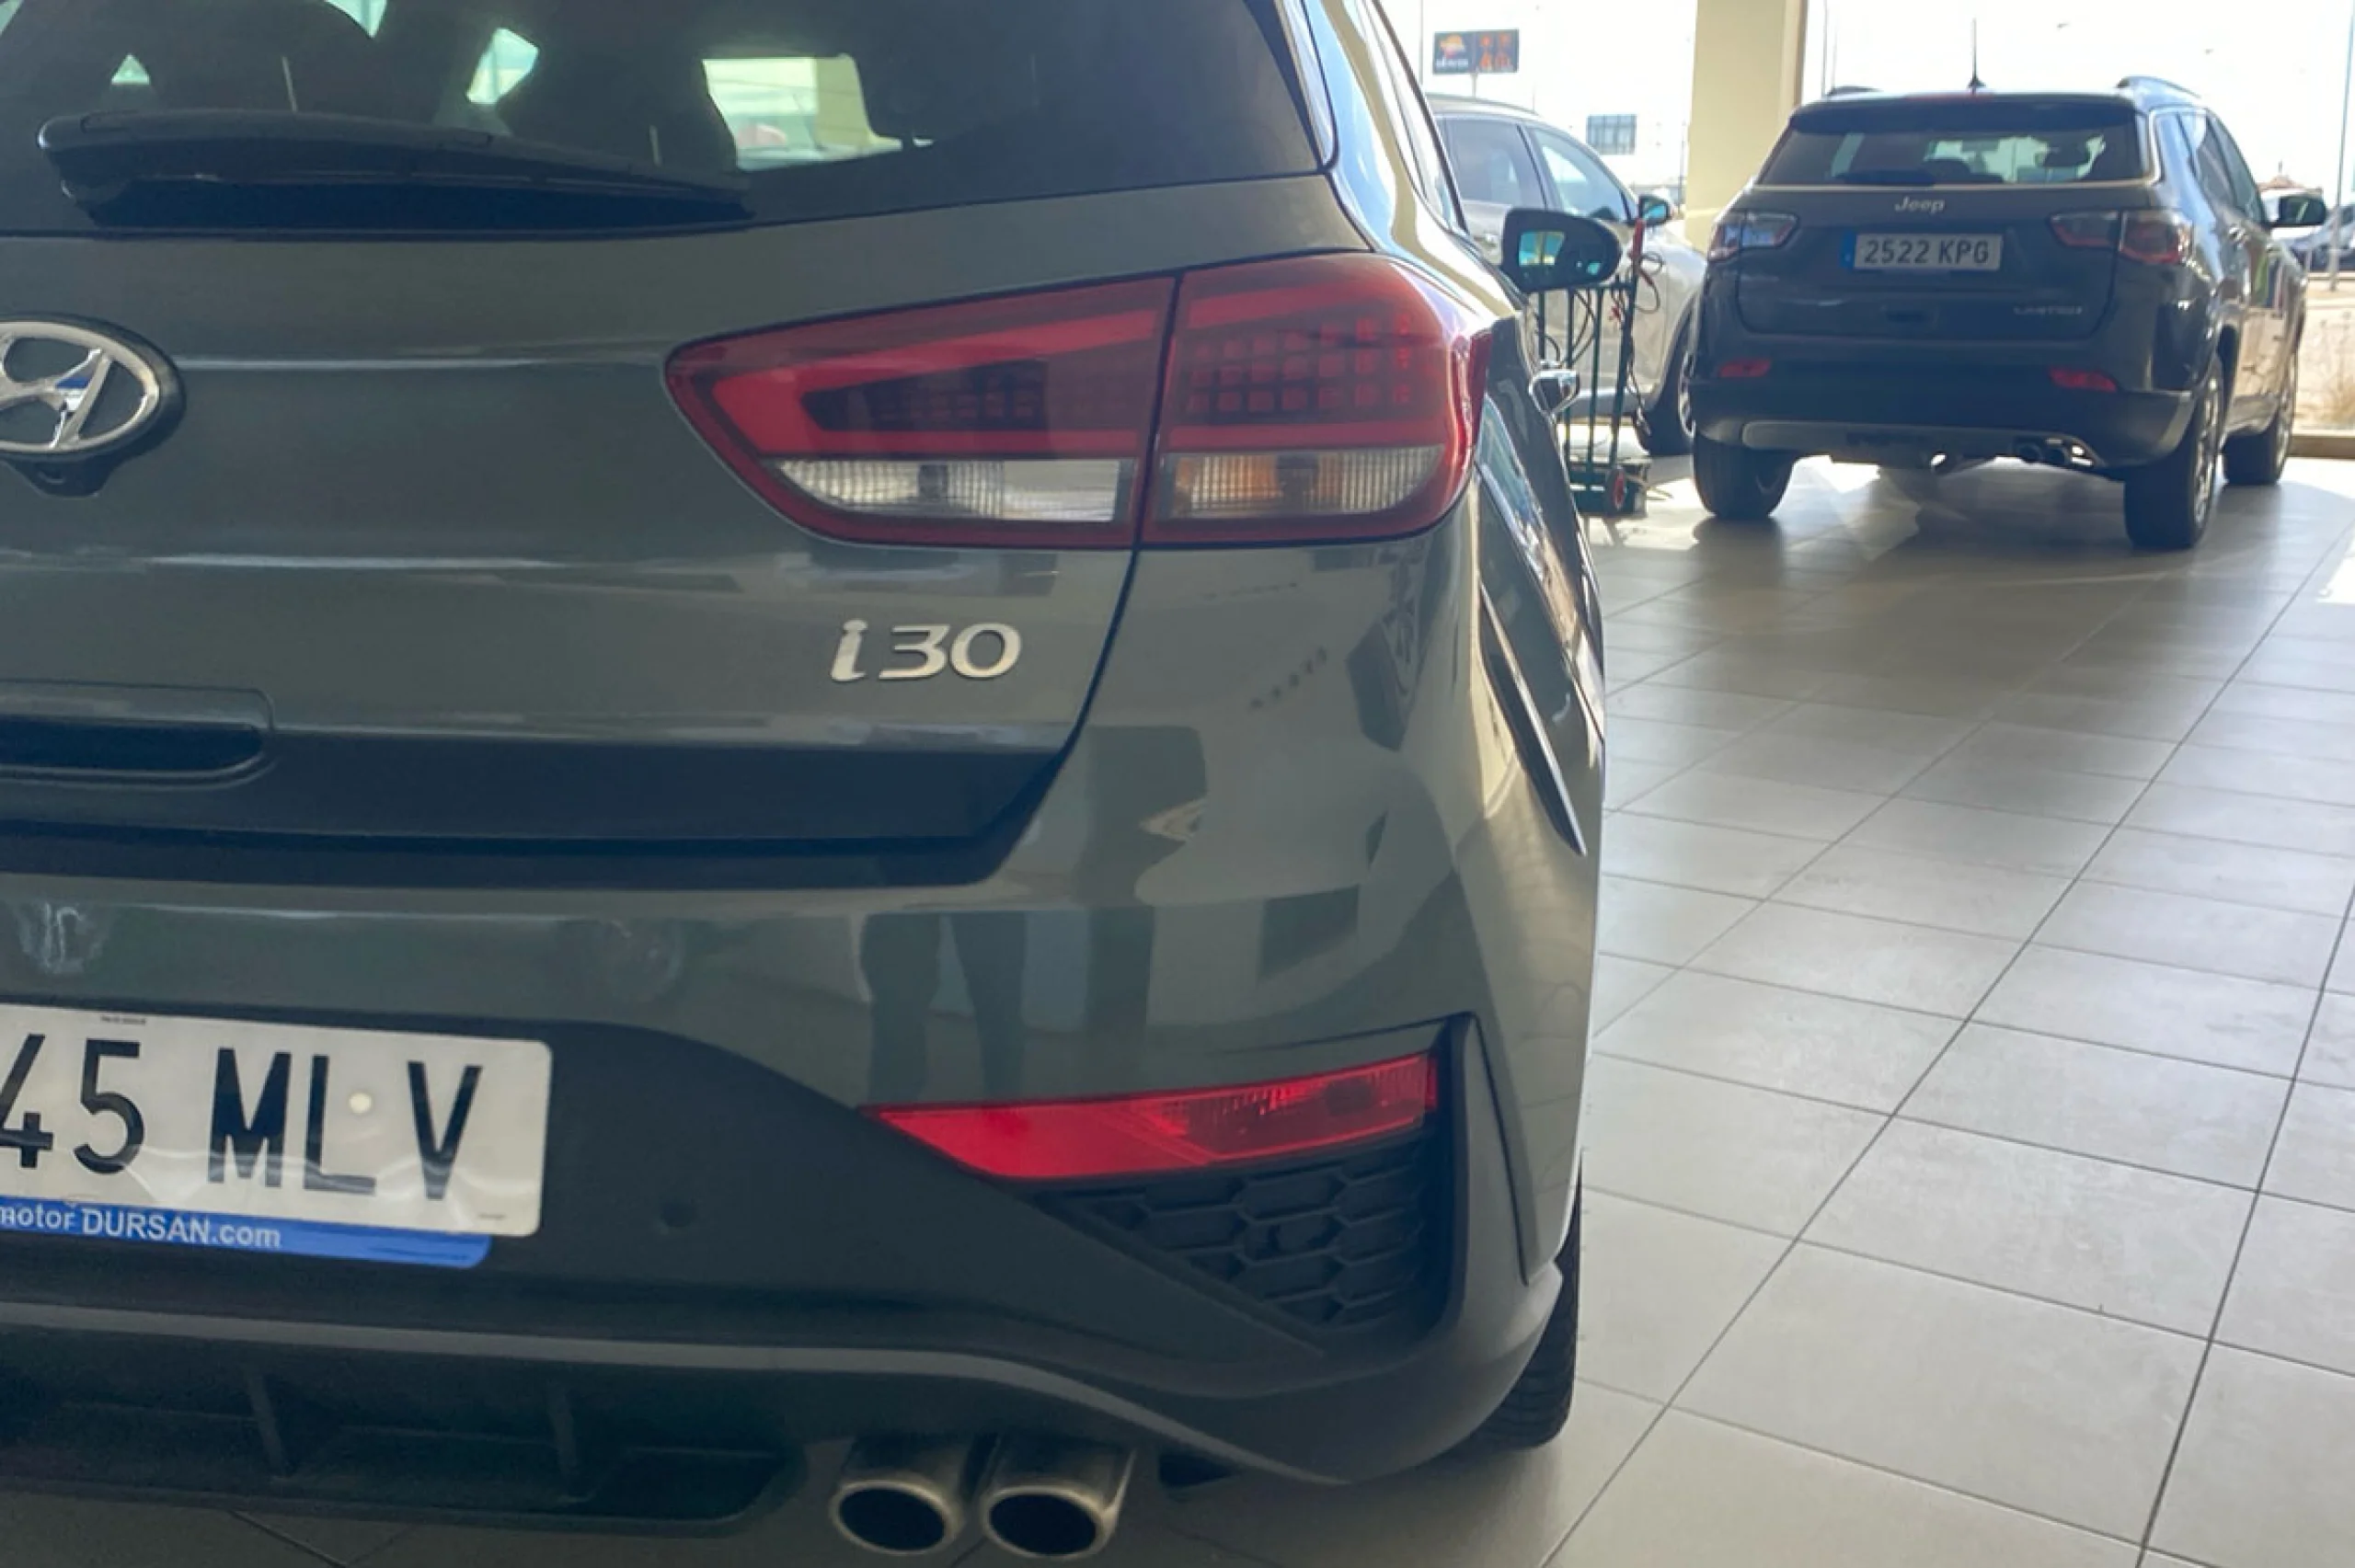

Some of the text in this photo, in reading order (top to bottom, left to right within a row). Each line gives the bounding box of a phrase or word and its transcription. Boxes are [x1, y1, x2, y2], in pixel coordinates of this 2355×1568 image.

[1894, 196, 1946, 214] Jeep
[1865, 239, 1989, 264] 2522 KPG
[0, 1033, 145, 1174] 45
